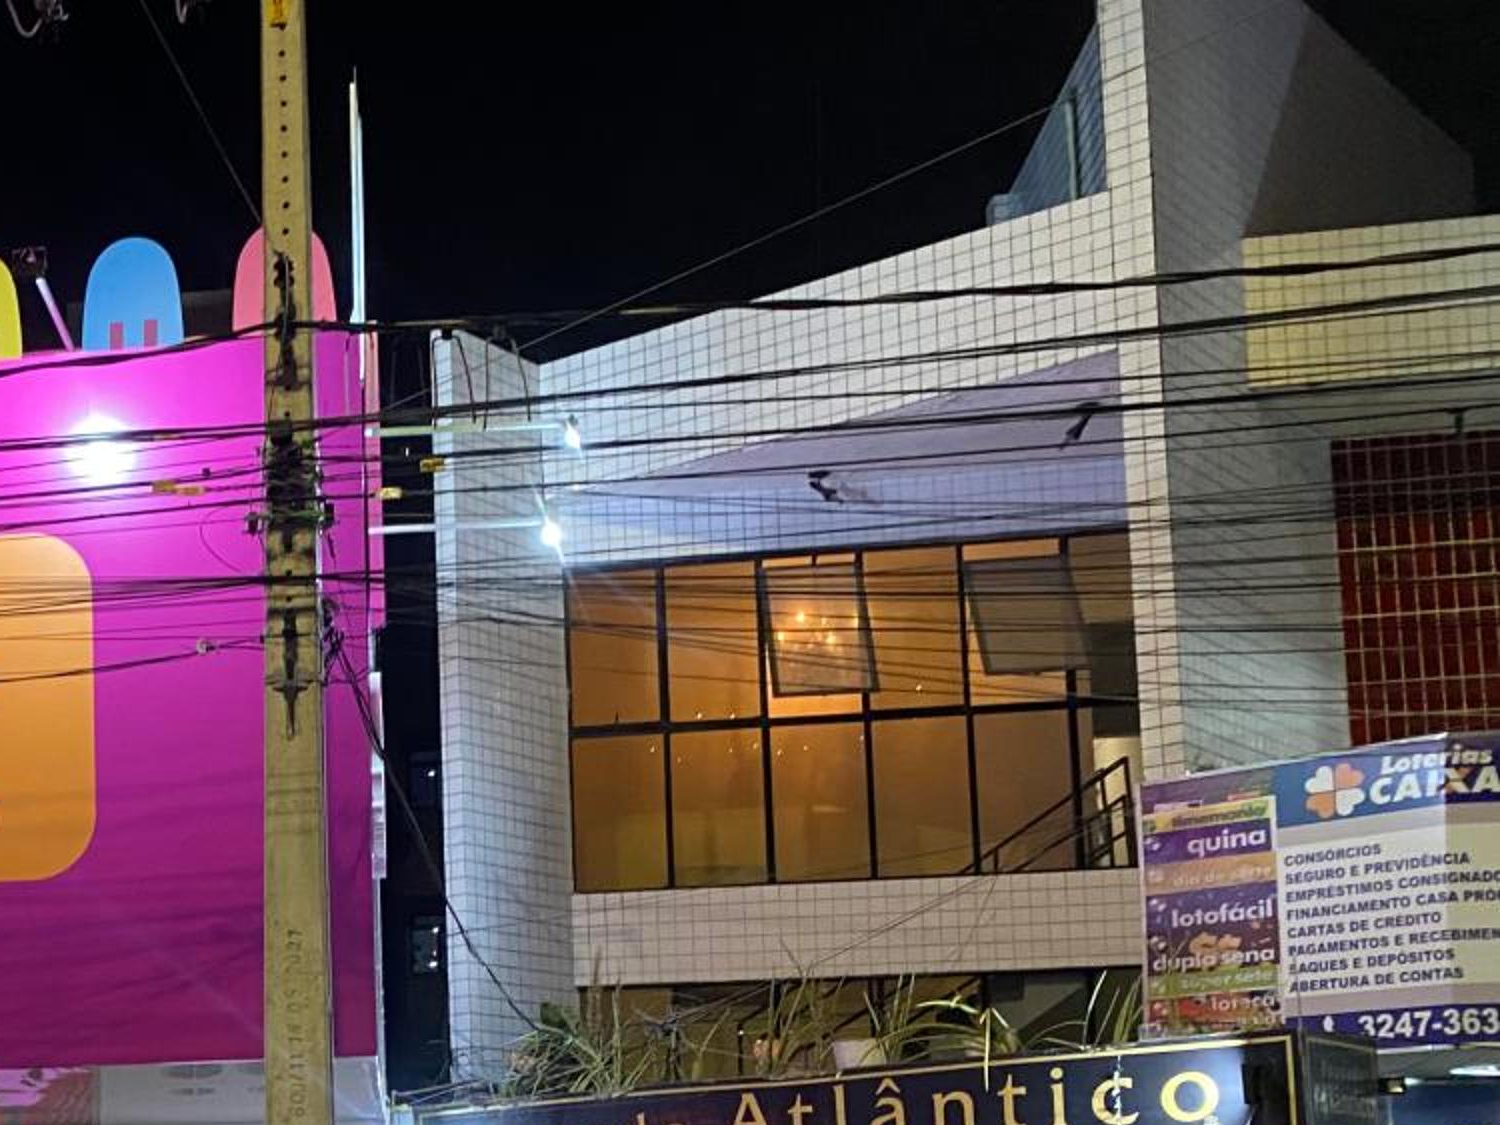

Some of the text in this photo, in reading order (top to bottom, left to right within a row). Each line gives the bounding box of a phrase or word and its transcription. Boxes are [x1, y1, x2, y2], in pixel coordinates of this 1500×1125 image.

[1381, 743, 1493, 775] Loterias
[1187, 828, 1267, 858] quina
[1285, 852, 1471, 885] SEGURO E PREVIDÊNCIA
[1171, 898, 1274, 928] lotofácil
[1286, 896, 1411, 920] FINANCIAMENTO
[1416, 891, 1460, 906] CASA
[1287, 922, 1345, 939] CARTAS
[1349, 919, 1370, 933] DE
[1288, 936, 1390, 956] PAGAMENTOS
[1394, 932, 1405, 947] E
[1353, 957, 1364, 969] E
[1289, 965, 1465, 993] ABERTURA DE CONTAS
[1357, 1007, 1500, 1038] 3247-363
